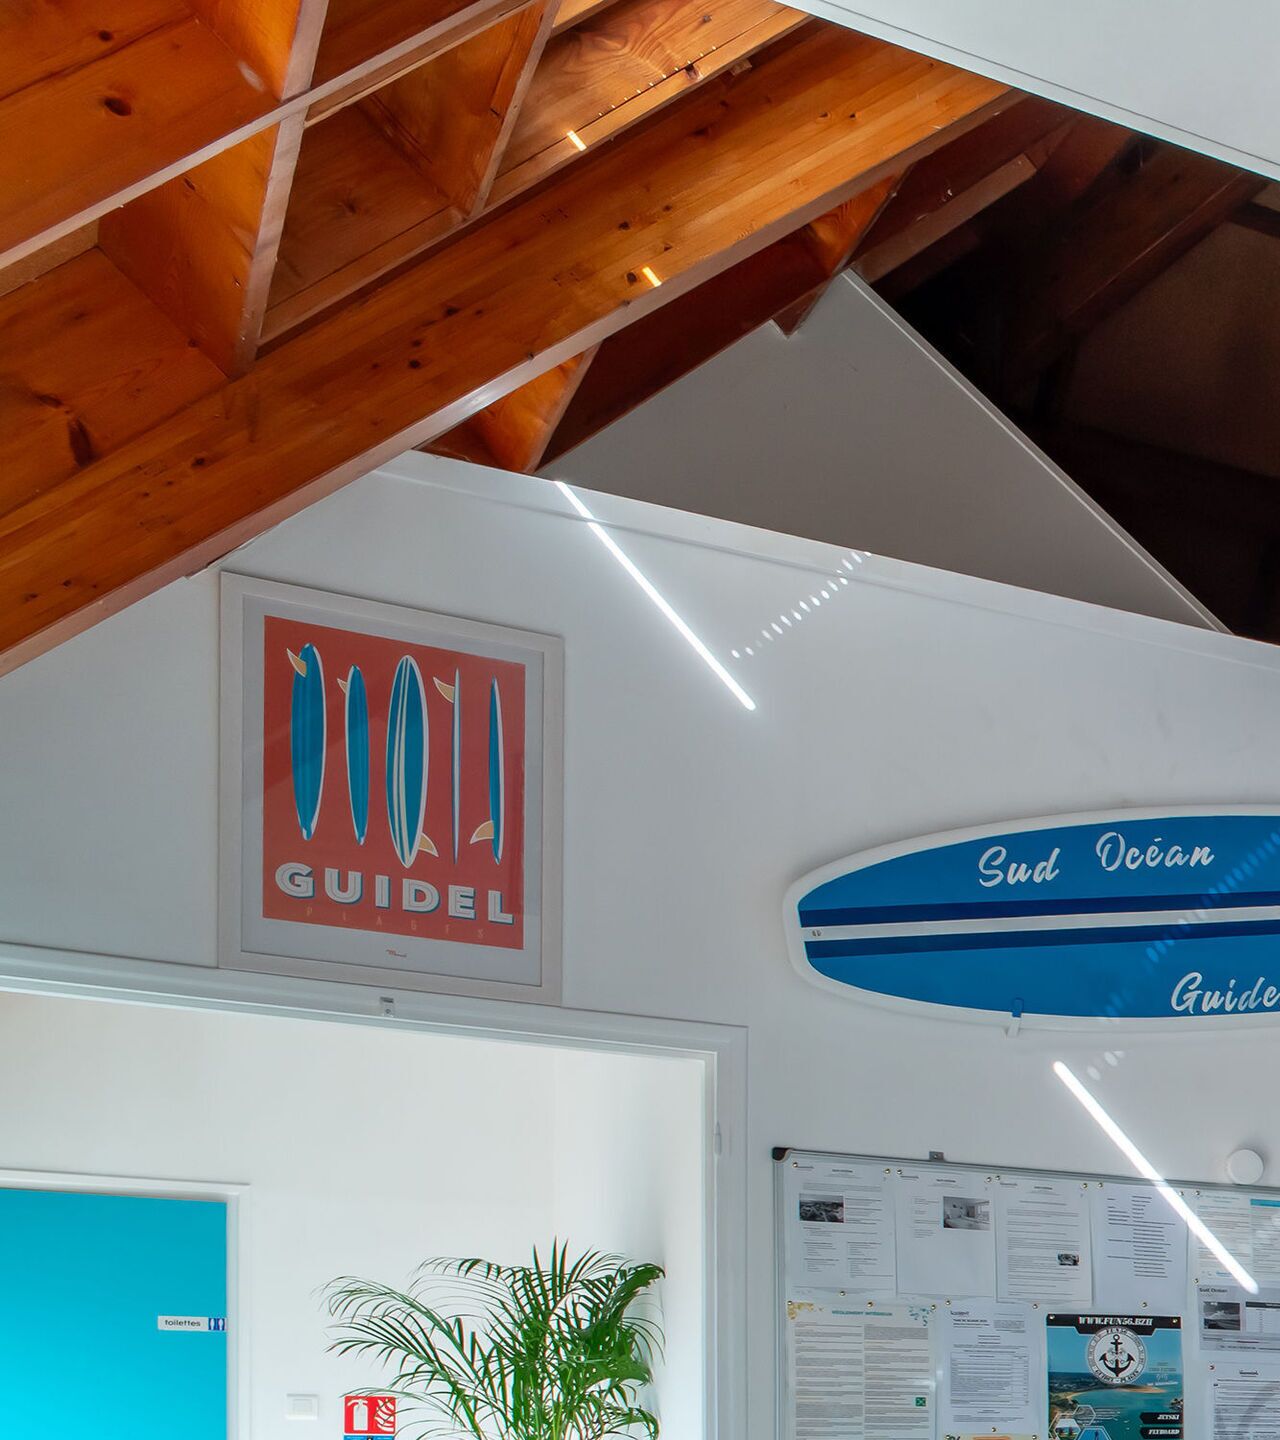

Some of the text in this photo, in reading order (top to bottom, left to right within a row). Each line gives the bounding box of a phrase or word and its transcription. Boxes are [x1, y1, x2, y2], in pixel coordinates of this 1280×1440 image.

[977, 831, 1216, 888] Sud Océan
[274, 861, 516, 926] GUIDEL
[164, 1319, 201, 1327] toilettes
[1078, 1316, 1154, 1326] WWW.FUN56.BZH
